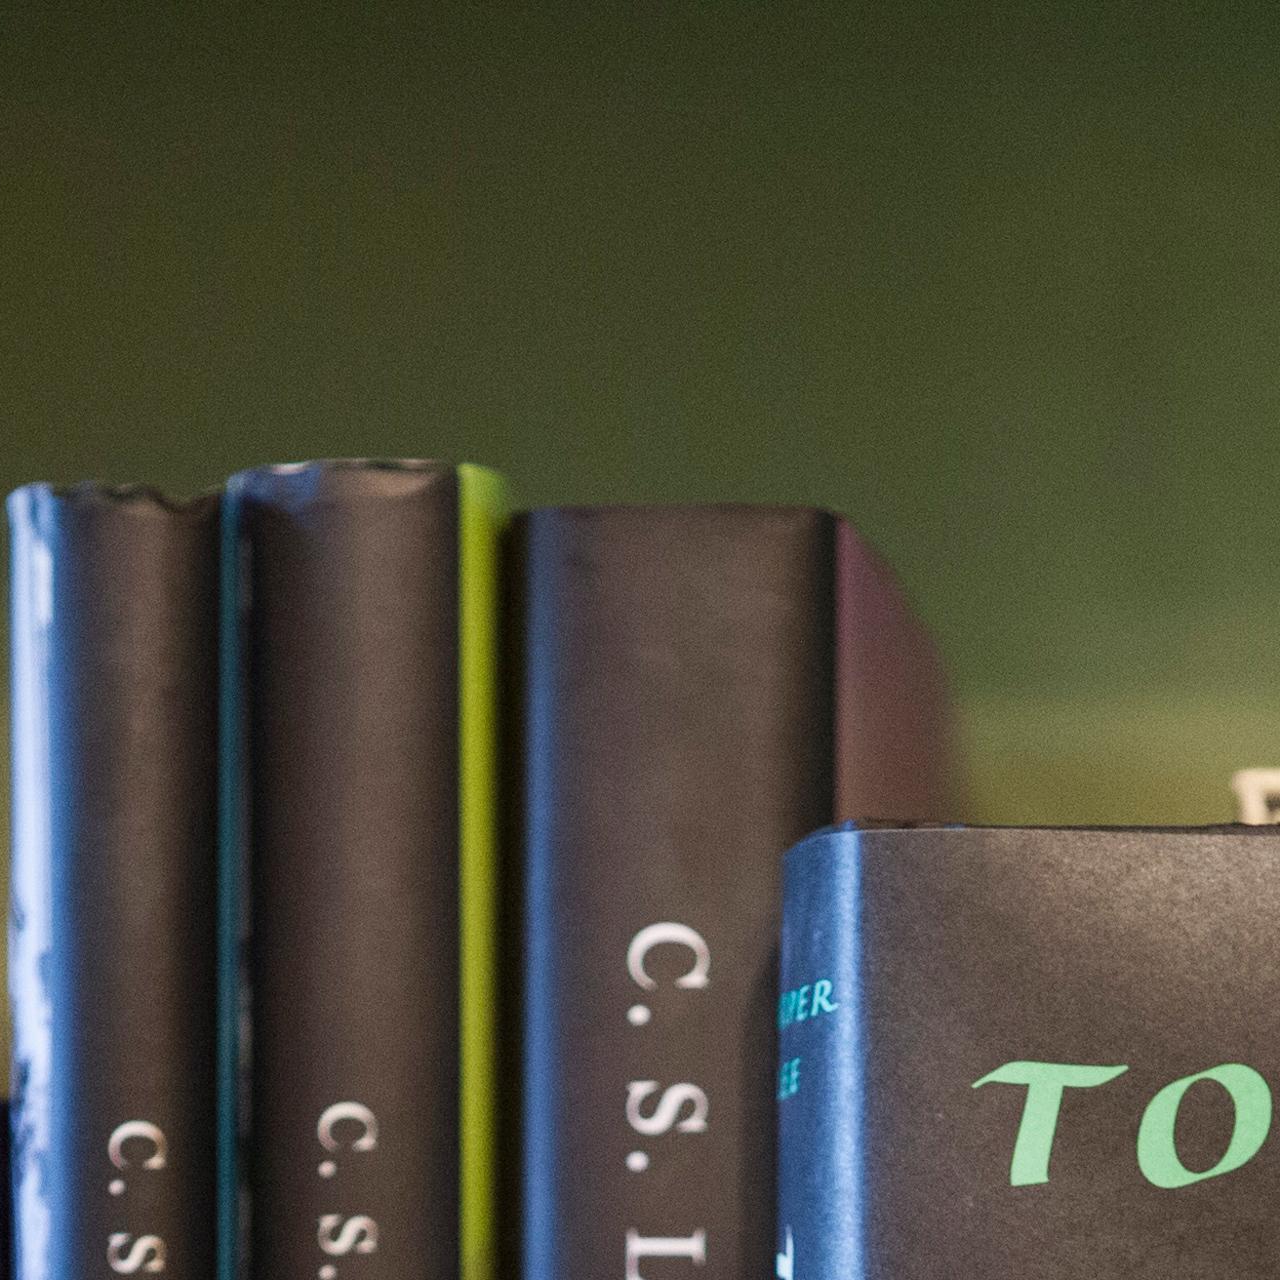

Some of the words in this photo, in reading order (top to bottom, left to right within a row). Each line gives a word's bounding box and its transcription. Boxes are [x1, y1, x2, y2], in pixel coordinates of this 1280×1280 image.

[627, 920, 711, 1026] C.
[108, 1119, 167, 1195] C.
[317, 1100, 378, 1179] C.
[626, 1078, 710, 1172] S.
[971, 1060, 1273, 1189] TO
